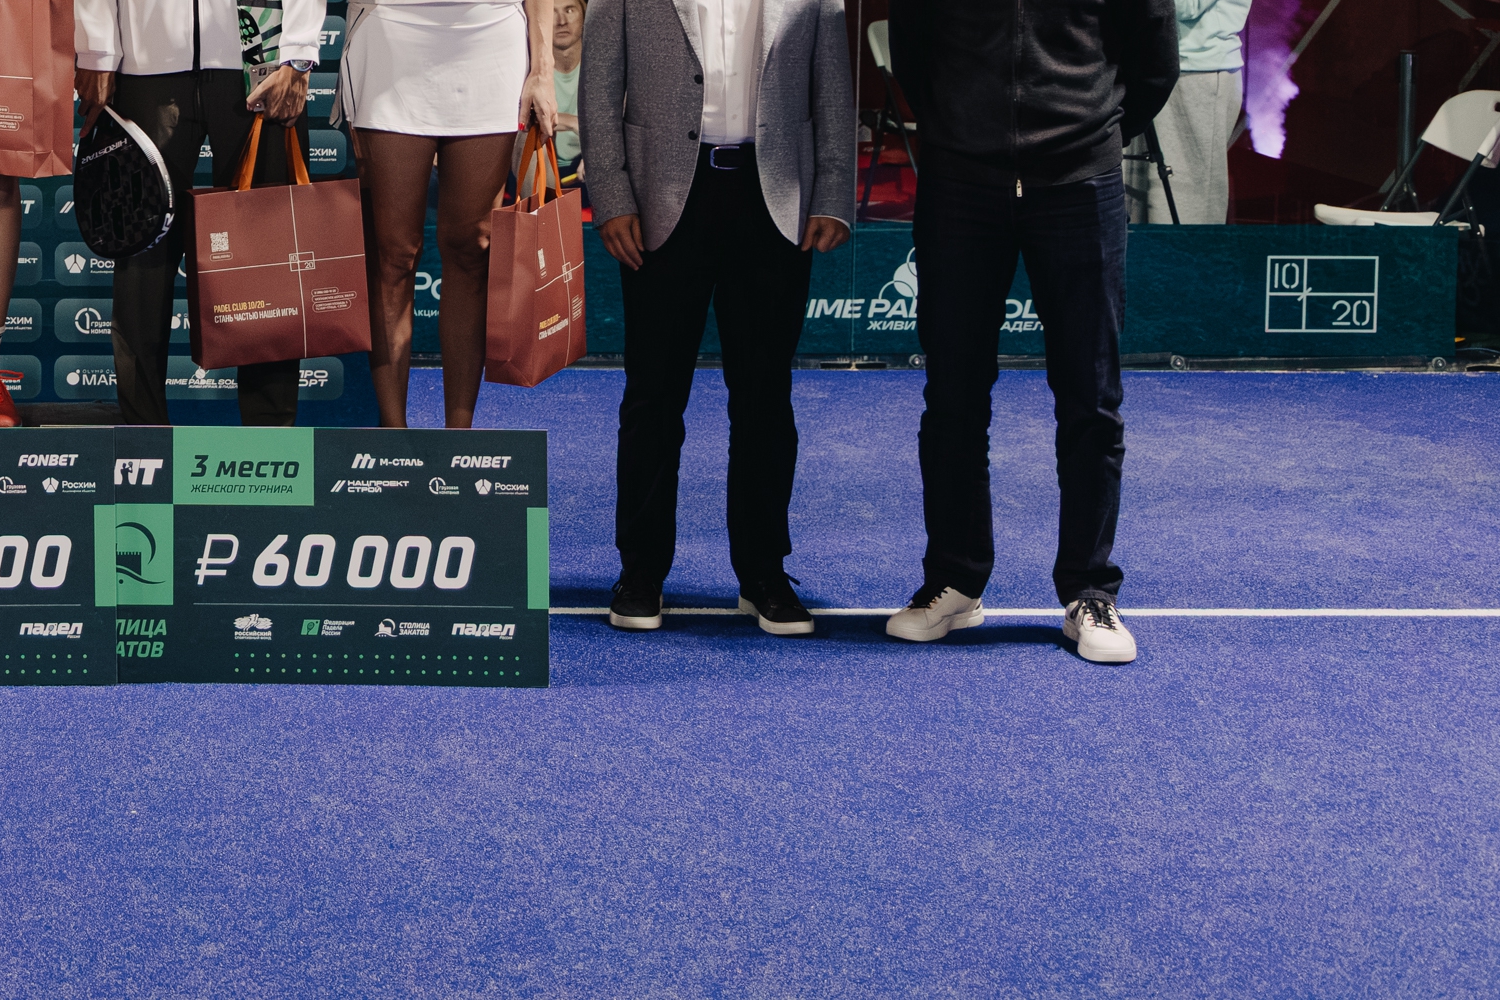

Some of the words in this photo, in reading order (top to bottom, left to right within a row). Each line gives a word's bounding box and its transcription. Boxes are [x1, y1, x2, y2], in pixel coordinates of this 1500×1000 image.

[1274, 263, 1299, 289] 10
[214, 303, 231, 313] PADEL
[232, 302, 247, 312] CLUB
[248, 300, 265, 310] 10/20
[1332, 300, 1370, 326] 20
[214, 314, 233, 323] СТАНЬ
[234, 312, 259, 322] ЧАСТЬЮ
[260, 308, 281, 319] НАШЕЙ
[281, 307, 298, 317] ИГРЫ
[867, 321, 916, 331] ЖИВИ
[18, 454, 79, 467] FONBET
[190, 455, 209, 478] 3
[215, 459, 299, 479] место
[380, 458, 424, 467] М-СТАЛЬ
[451, 456, 511, 468] FONBET
[62, 481, 96, 489] Росхим
[190, 483, 245, 493] ЖЕНСКОГО
[247, 484, 293, 494] ТУРНИРА
[495, 482, 529, 491] Росхим
[252, 534, 336, 588] 60
[346, 535, 476, 589] 000
[19, 622, 84, 636] падел
[116, 619, 167, 639] ЛИЦА
[323, 619, 355, 627] Федерация
[399, 622, 430, 630] СТОЛИЦА
[399, 628, 429, 636] ЗАКАТОВ
[451, 623, 516, 637] падел
